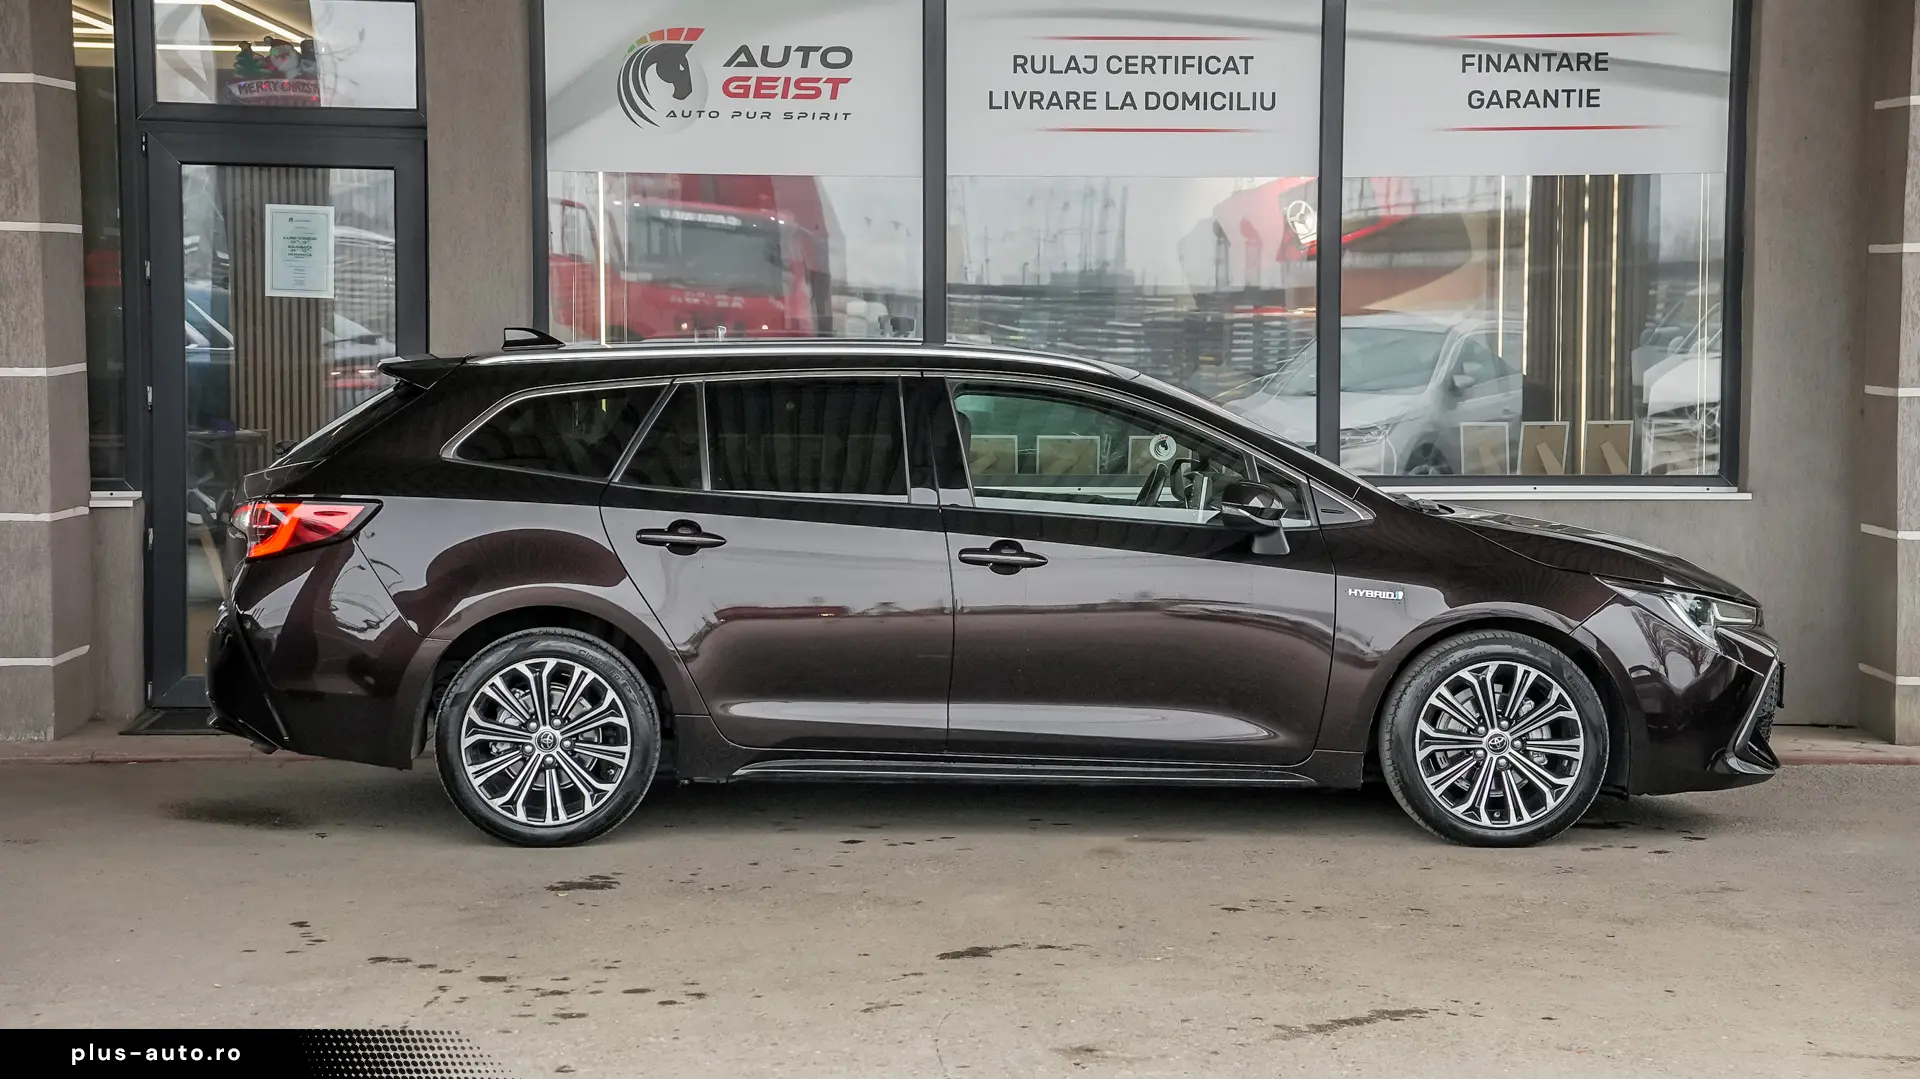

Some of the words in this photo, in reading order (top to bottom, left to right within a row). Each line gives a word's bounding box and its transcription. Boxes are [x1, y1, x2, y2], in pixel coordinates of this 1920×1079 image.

[722, 44, 853, 69] AUTO
[1012, 54, 1098, 75] RULAJ
[1106, 55, 1254, 75] CERTIFICAT
[1461, 52, 1609, 73] FINANTARE
[238, 81, 277, 95] MERRY
[281, 80, 320, 95] CHRIST
[722, 76, 852, 100] GEIST
[988, 90, 1098, 110] LIVRARE
[1105, 91, 1138, 111] LA
[1144, 91, 1276, 111] DOMICILIU
[1467, 88, 1601, 109] GARANTIE
[665, 109, 720, 119] AUTO
[731, 110, 771, 120] PUR
[783, 111, 852, 121] SPIRIT
[1348, 588, 1397, 600] HYBRID
